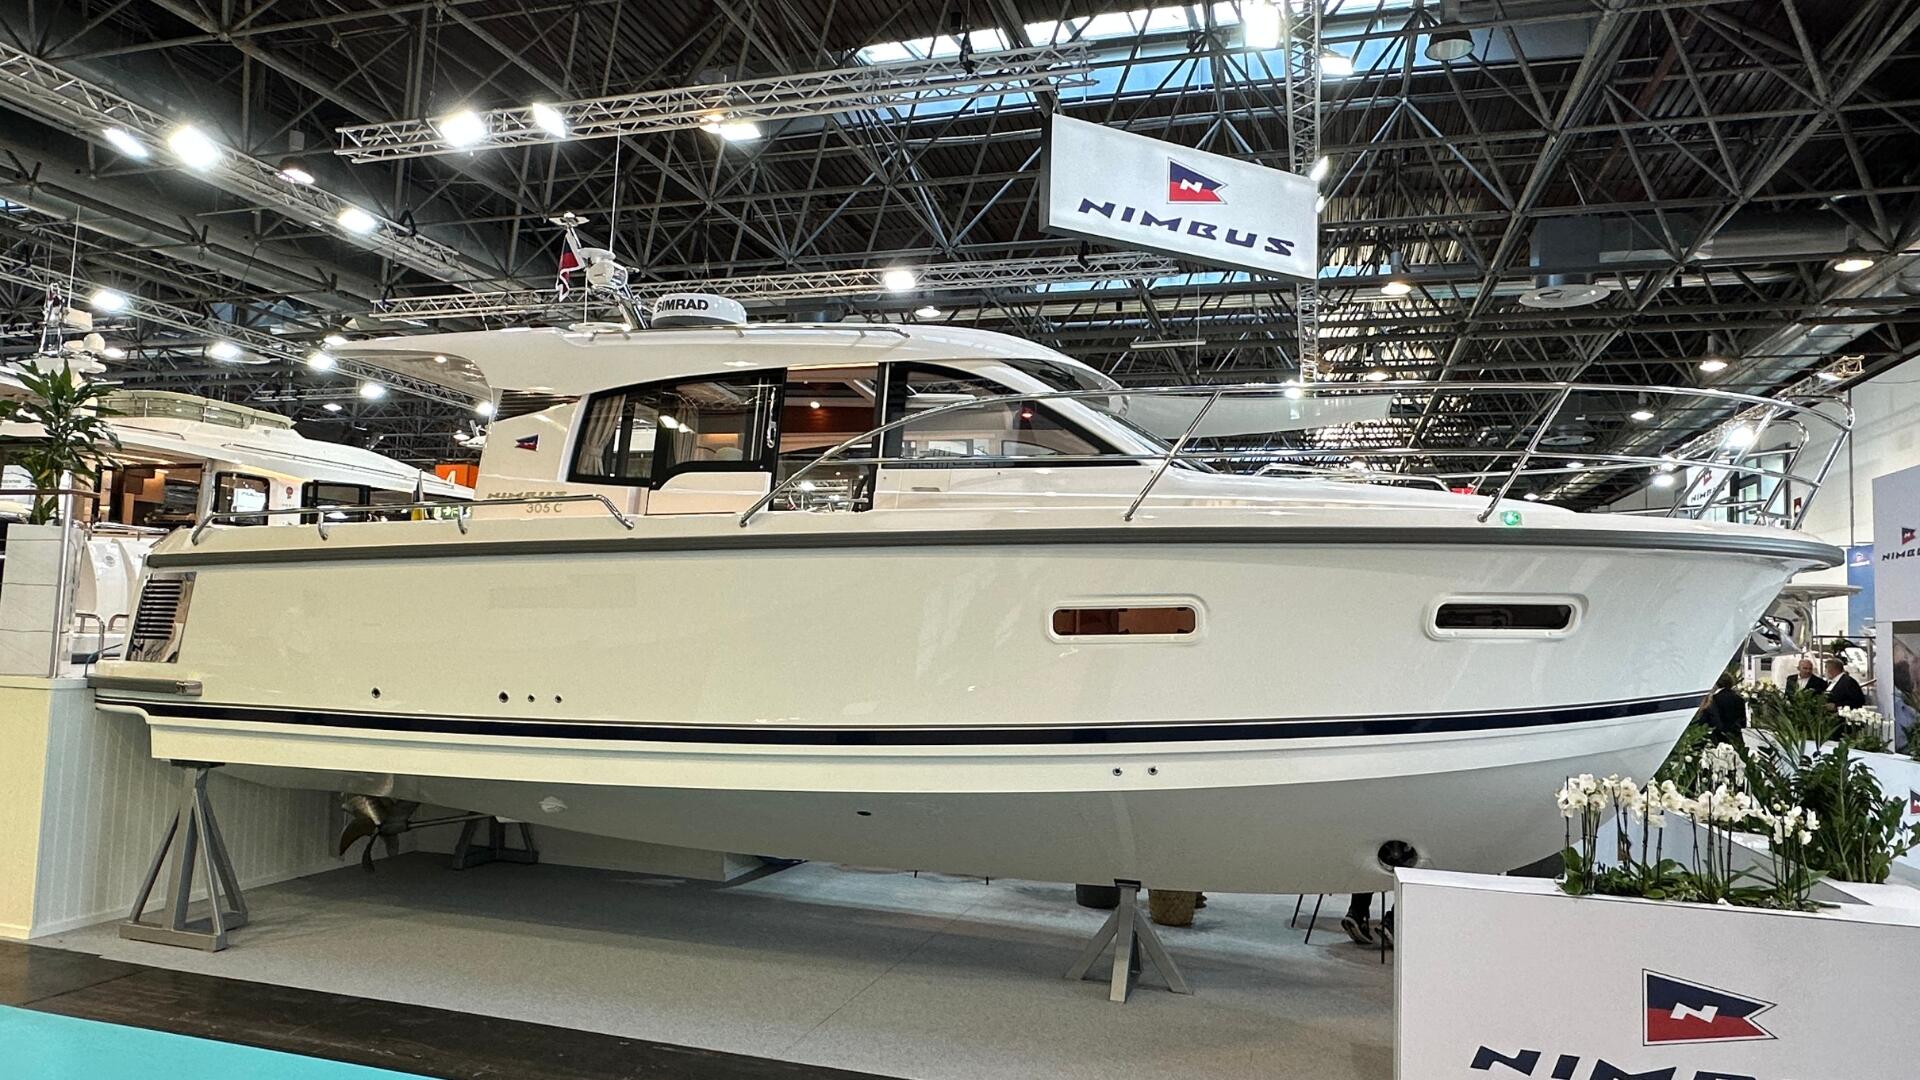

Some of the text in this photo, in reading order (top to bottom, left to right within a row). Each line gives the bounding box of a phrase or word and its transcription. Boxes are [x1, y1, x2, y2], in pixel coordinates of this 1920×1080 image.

[1078, 198, 1295, 256] NIMBUS
[656, 298, 709, 313] SIMRAD
[526, 503, 562, 513] 305 C
